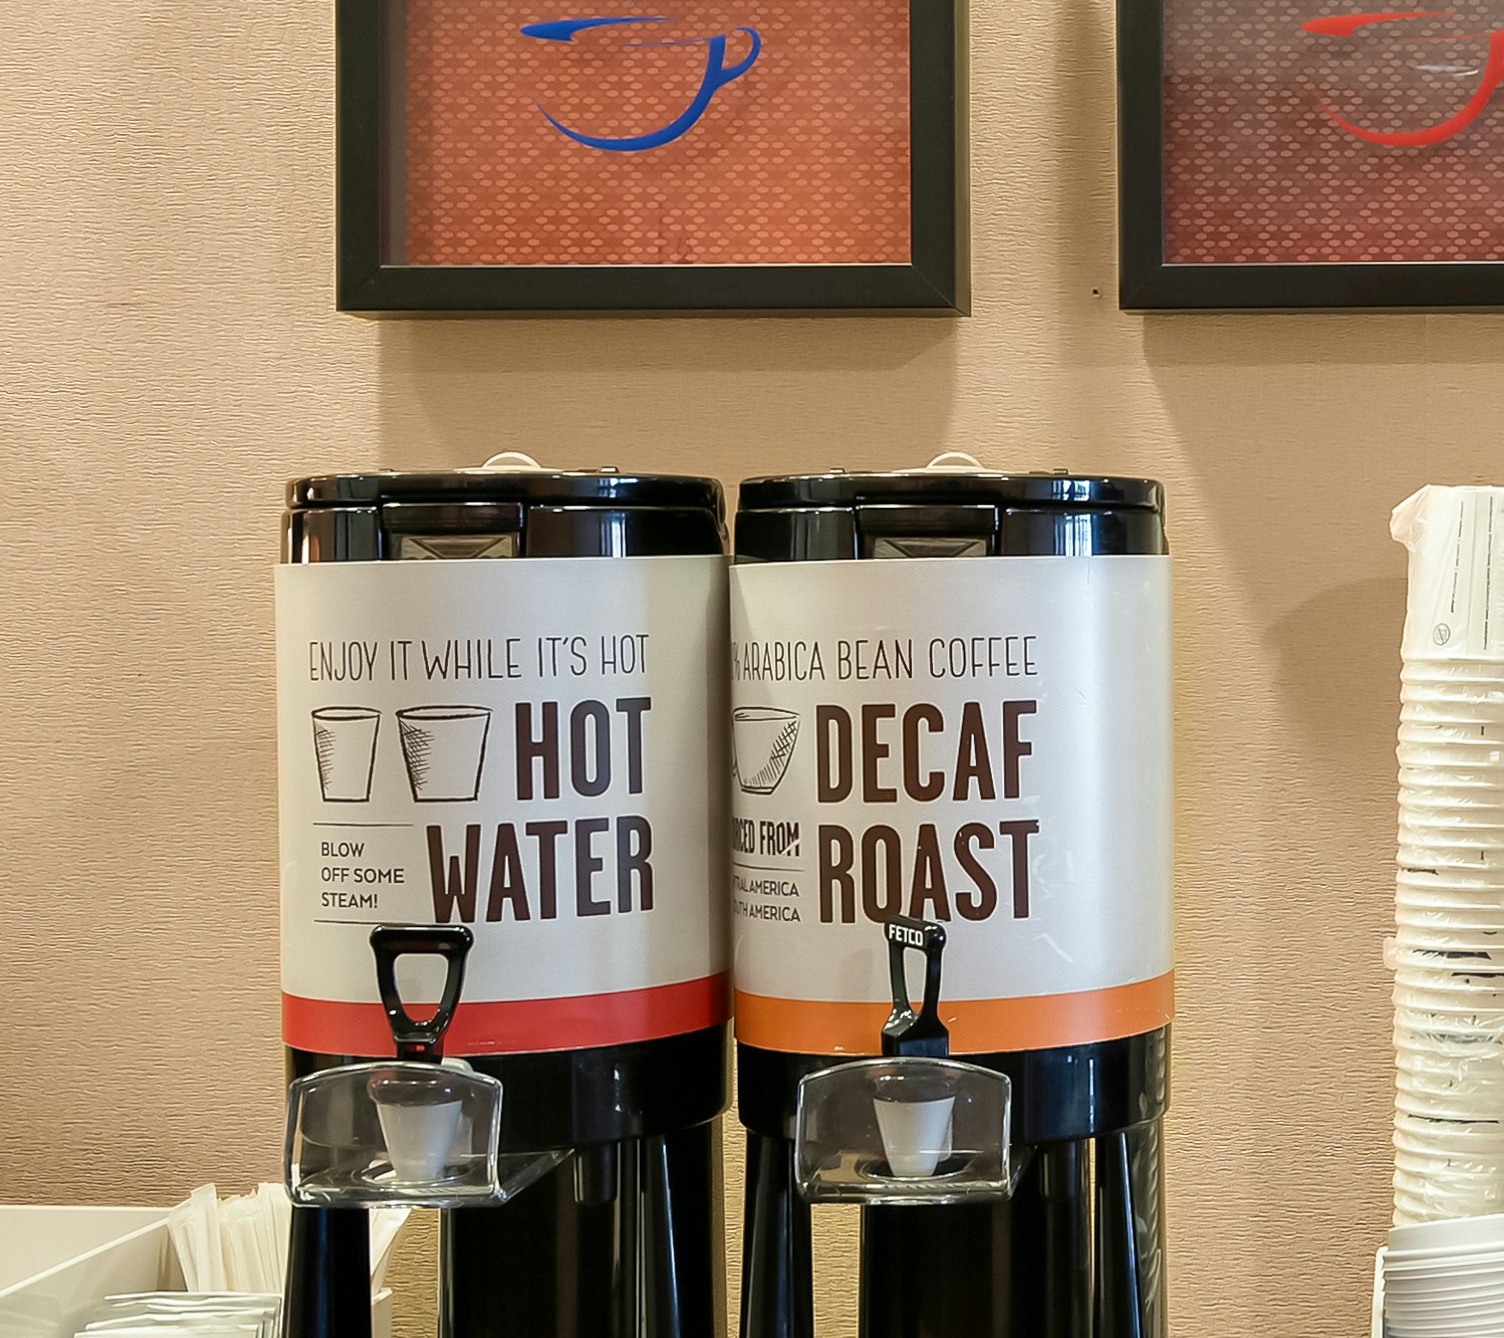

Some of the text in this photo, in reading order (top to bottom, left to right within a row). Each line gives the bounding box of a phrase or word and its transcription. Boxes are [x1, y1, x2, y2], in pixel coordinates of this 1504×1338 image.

[309, 634, 650, 681] ENJOY IT WHILE IT'S HOT
[743, 639, 826, 681] ARABICA
[837, 638, 914, 680] BEAN
[928, 635, 1039, 678] COFFEE
[515, 696, 652, 801] HOT
[815, 699, 1038, 803] DECAF
[320, 841, 366, 858] BLOW
[759, 820, 800, 857] FROM
[320, 866, 406, 884] OFF SOME
[426, 815, 655, 924] WATER
[817, 819, 1040, 924] ROAST
[320, 891, 379, 909] STEAM!
[749, 879, 800, 898] AMERICA
[749, 904, 801, 922] AMERICA
[888, 923, 924, 946] FETCO
